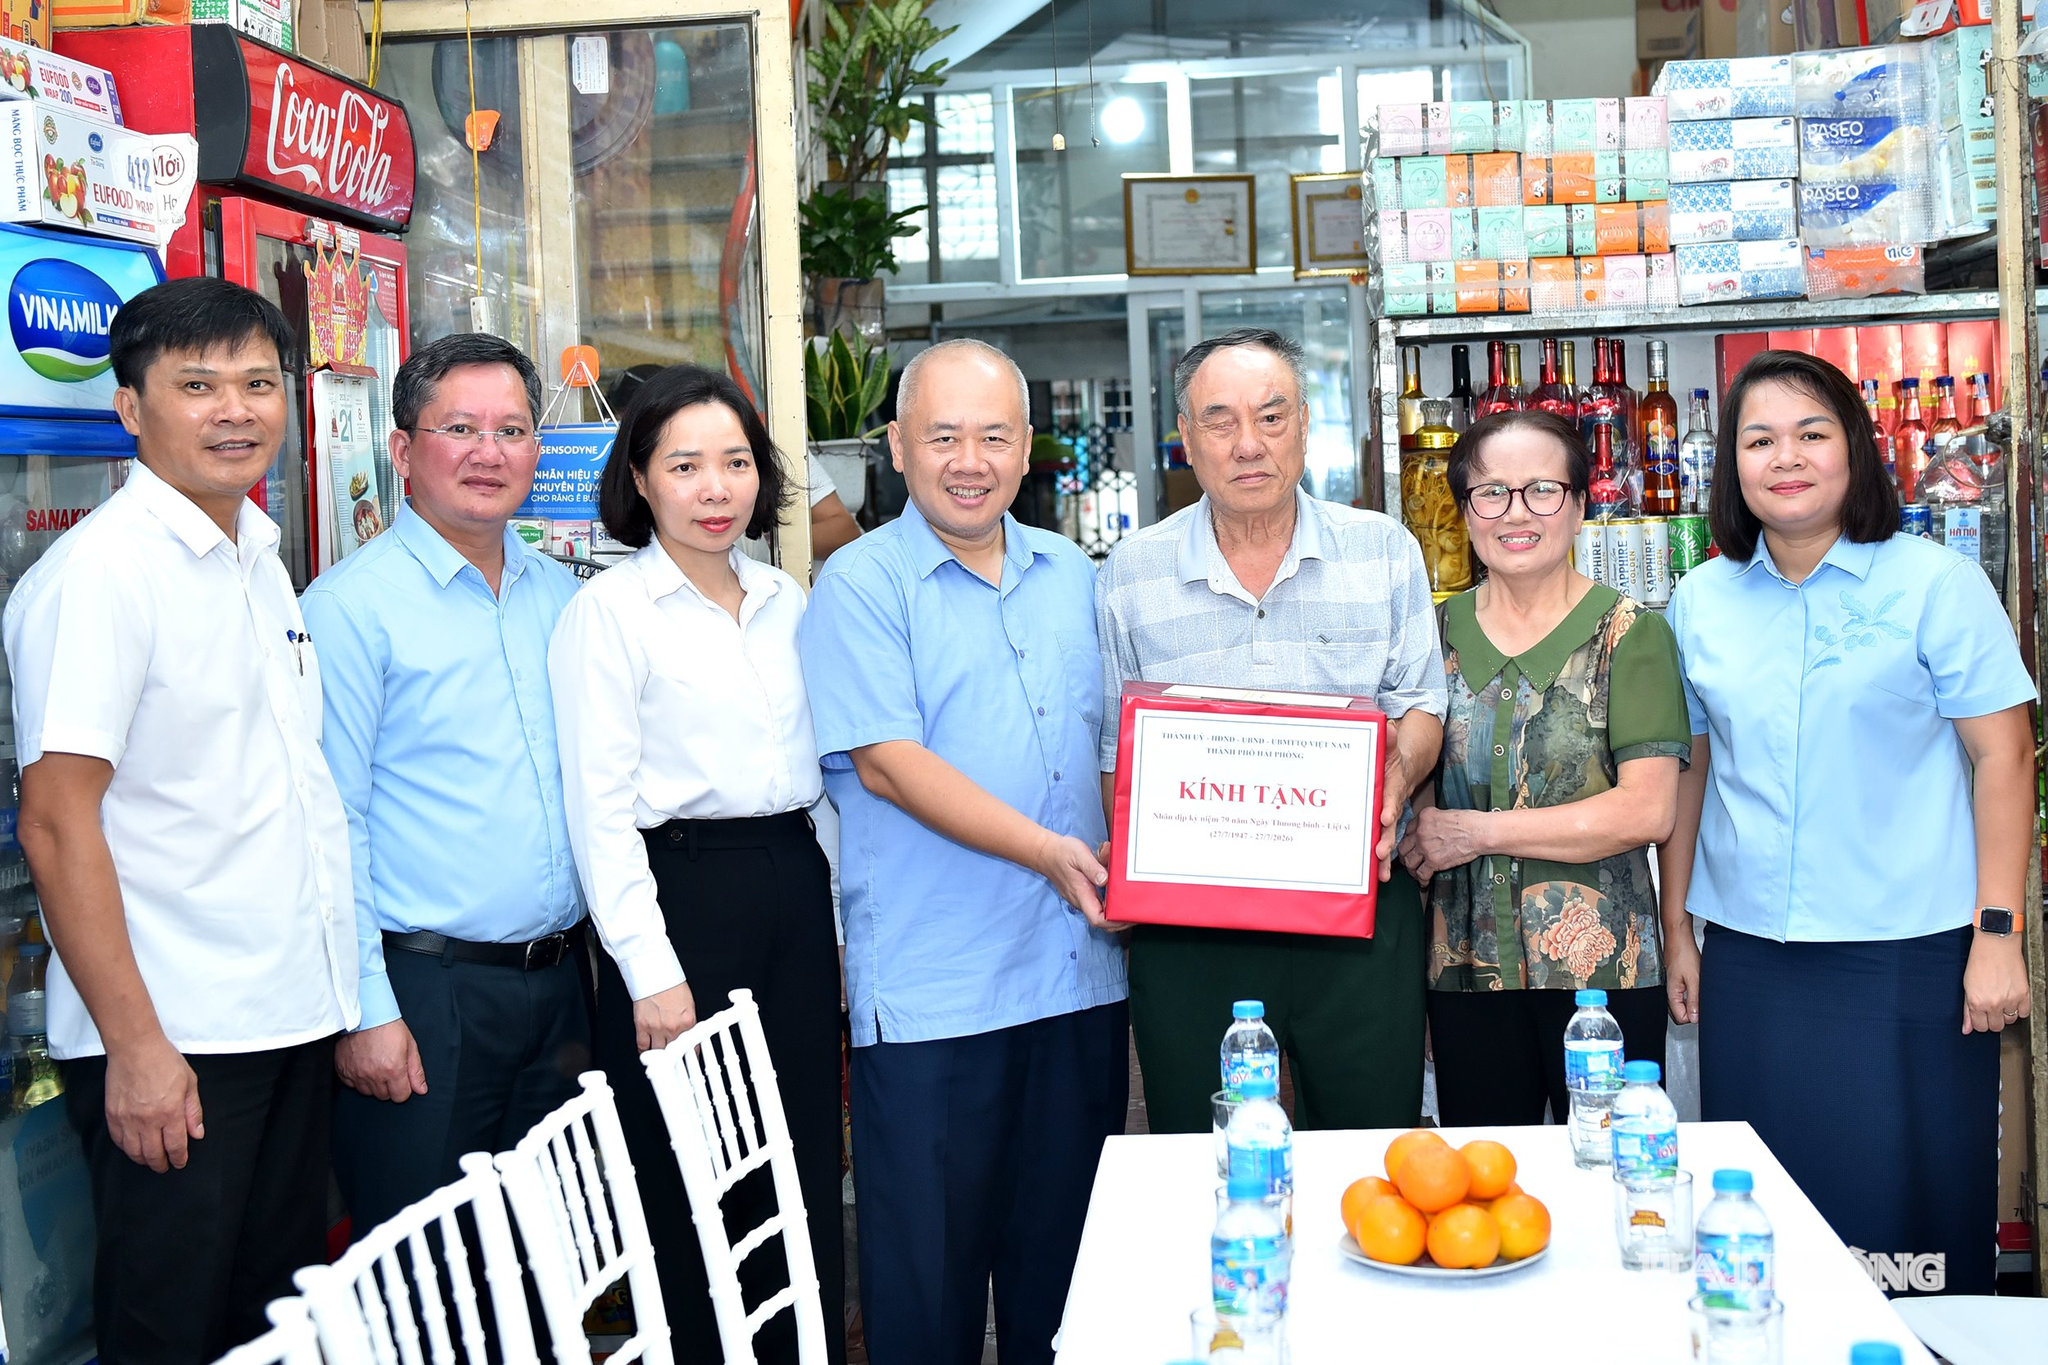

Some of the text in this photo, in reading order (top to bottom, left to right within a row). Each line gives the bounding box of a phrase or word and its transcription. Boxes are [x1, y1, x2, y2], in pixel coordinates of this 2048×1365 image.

[39, 67, 70, 89] EUFOOD
[59, 88, 73, 105] 200
[267, 62, 393, 206] Coca-Cola
[1807, 120, 1864, 140] PASEO
[127, 154, 152, 193] 412
[93, 183, 154, 215] EUFOOD WRAP
[19, 293, 119, 336] VINAMILK
[340, 409, 354, 442] 21
[541, 445, 598, 455] SENSODYNE
[533, 481, 574, 493] KHUYÊN
[534, 468, 564, 480] NHÃN
[567, 468, 591, 482] HIỆU
[531, 494, 550, 503] CHO
[551, 493, 575, 503] RĂNG
[1592, 540, 1603, 583] PPHIRE
[1618, 540, 1631, 595] SAPPHIRE
[1644, 538, 1657, 593] SAPPHIRE
[1179, 777, 1327, 810] KÍNH TẶNG
